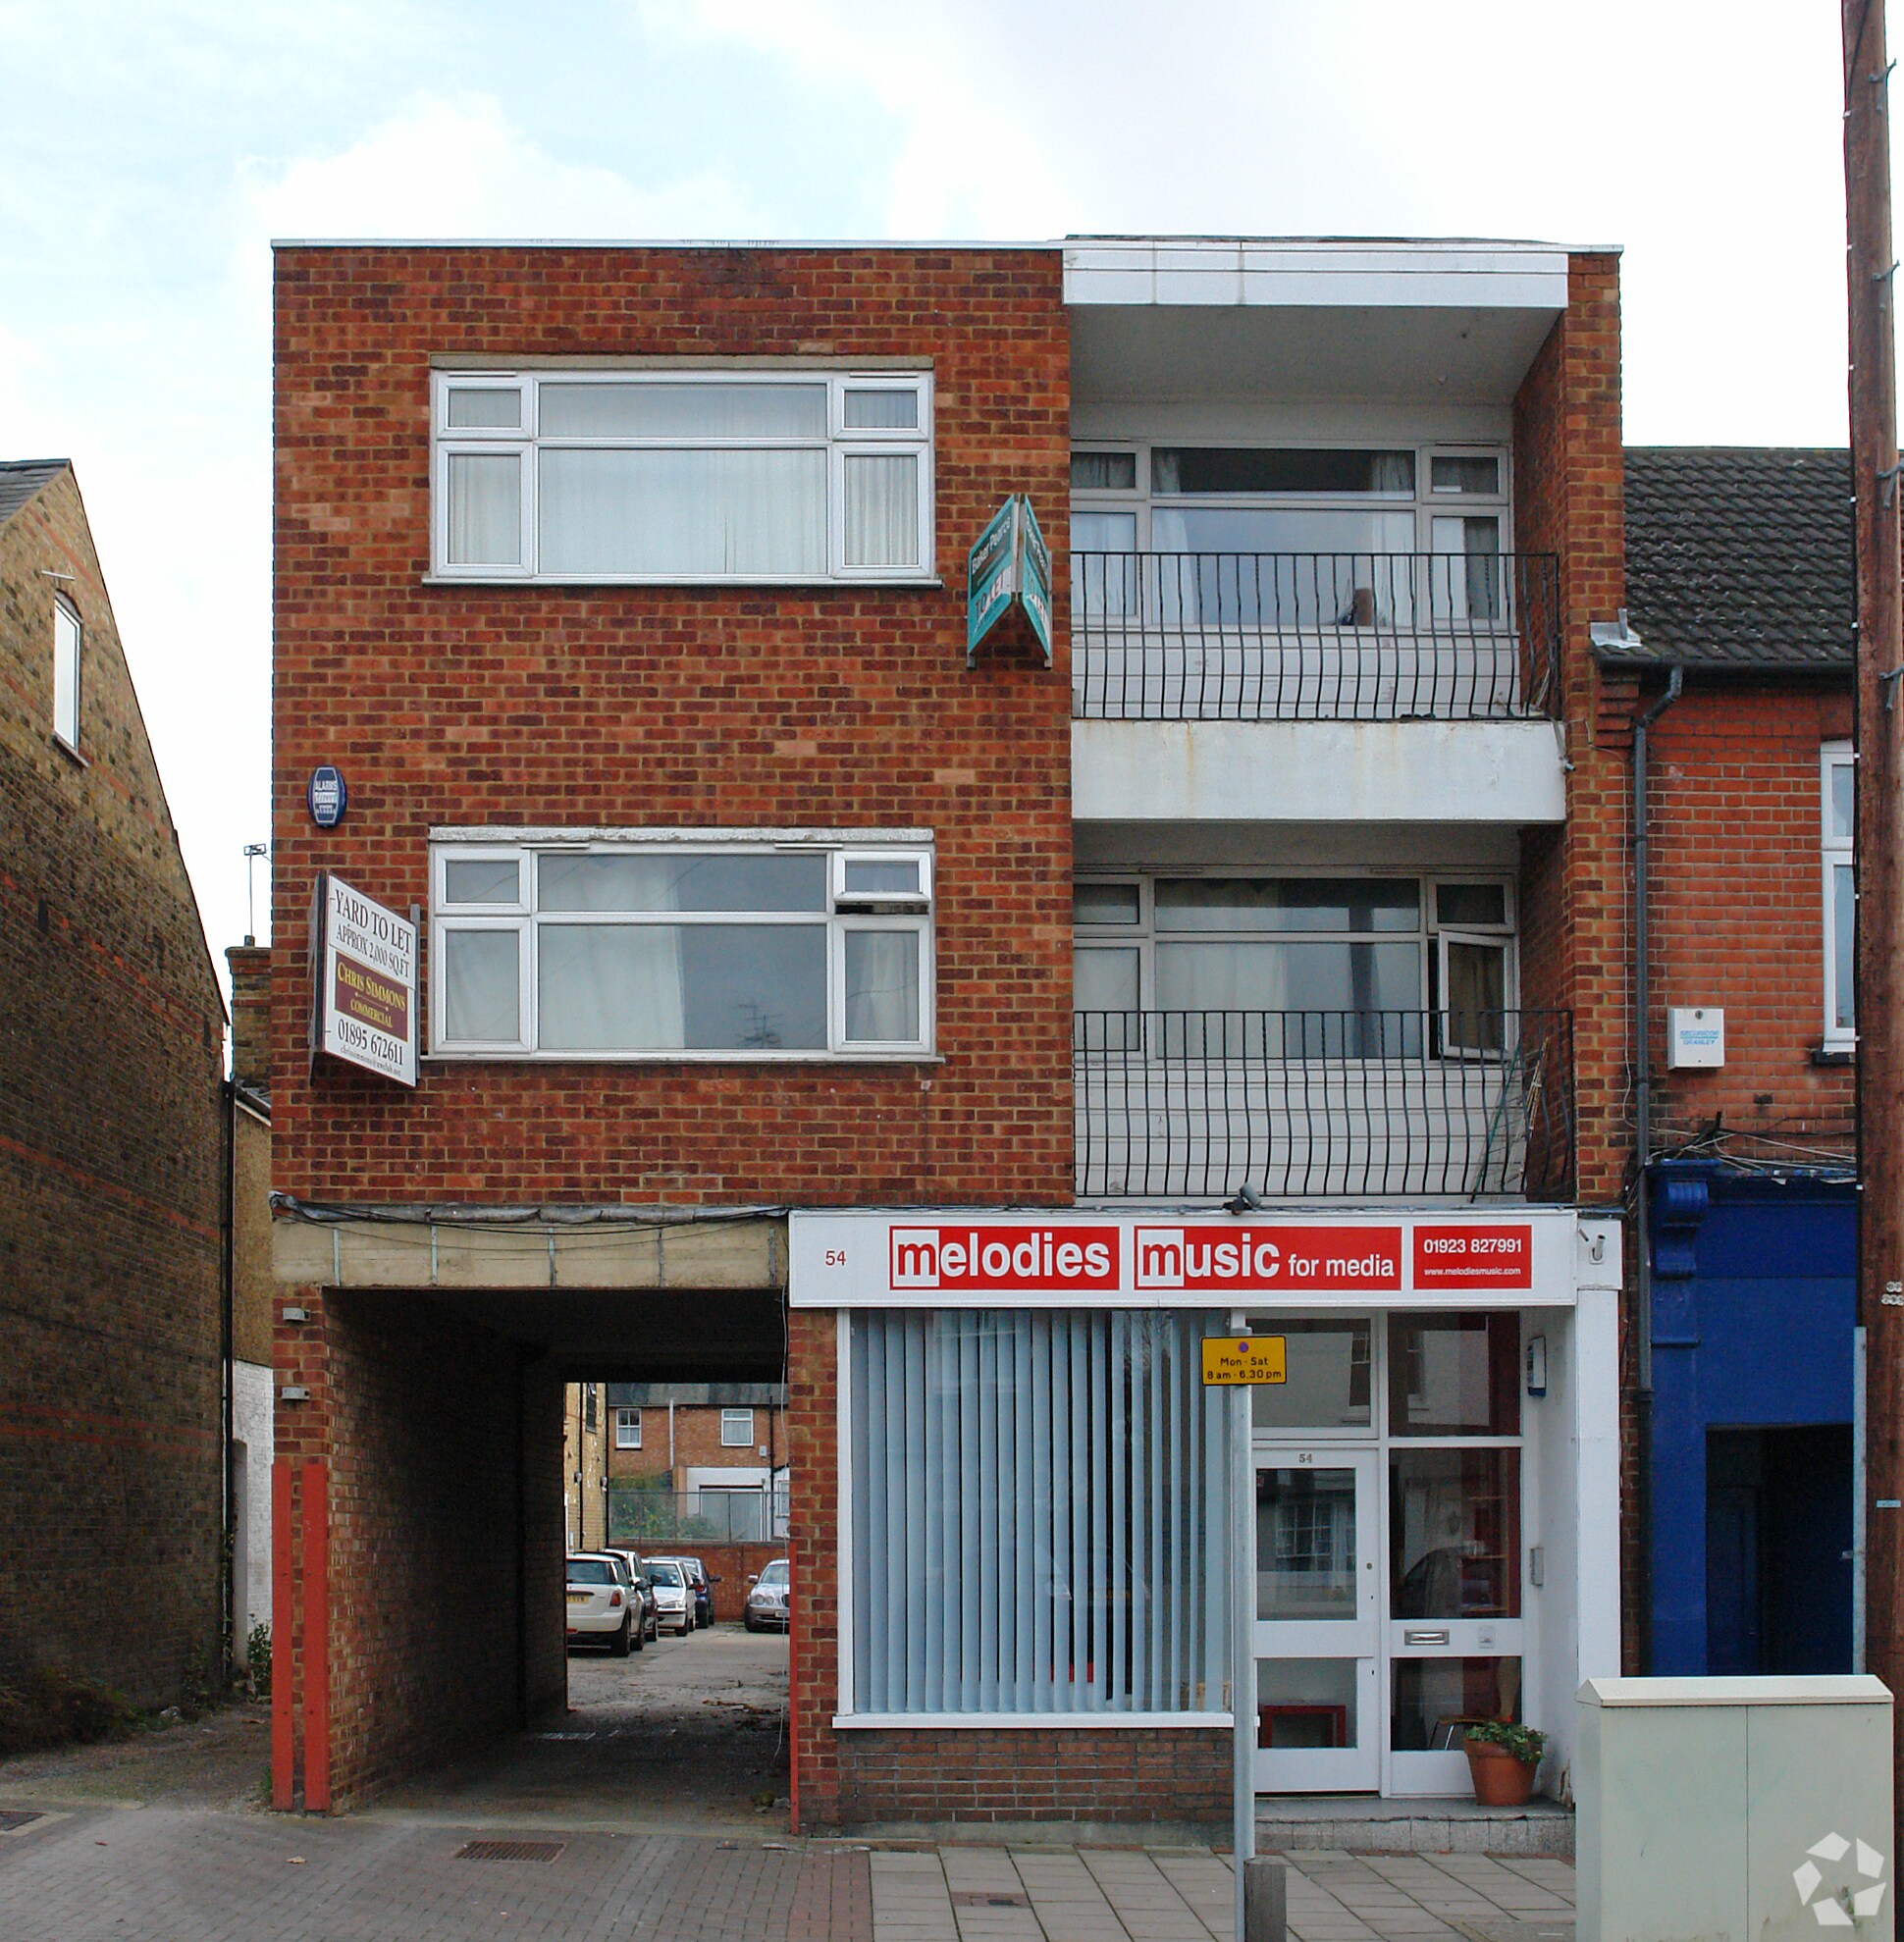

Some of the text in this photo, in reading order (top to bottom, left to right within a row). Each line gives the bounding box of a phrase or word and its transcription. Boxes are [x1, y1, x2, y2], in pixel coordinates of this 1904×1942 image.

[976, 592, 987, 620] TO
[990, 568, 1004, 603] LET
[335, 888, 412, 955] YARD TO LET
[337, 923, 368, 956] APPROX
[369, 942, 389, 966] 2,000
[337, 962, 406, 1012] CHRIS SIMMONS
[349, 998, 393, 1029] COMMERCIAL
[338, 1019, 403, 1066] 01895 672611
[824, 1250, 846, 1266] 54
[897, 1233, 1110, 1277] melodies
[1142, 1233, 1395, 1278] music for media
[1424, 1238, 1522, 1253] 01923 827991
[1424, 1267, 1521, 1276] www.melodiesmusic.com
[1220, 1357, 1242, 1366] Mon
[1250, 1356, 1268, 1366] Sat
[1239, 1370, 1264, 1379] 6.30
[1298, 1453, 1313, 1463] 54
